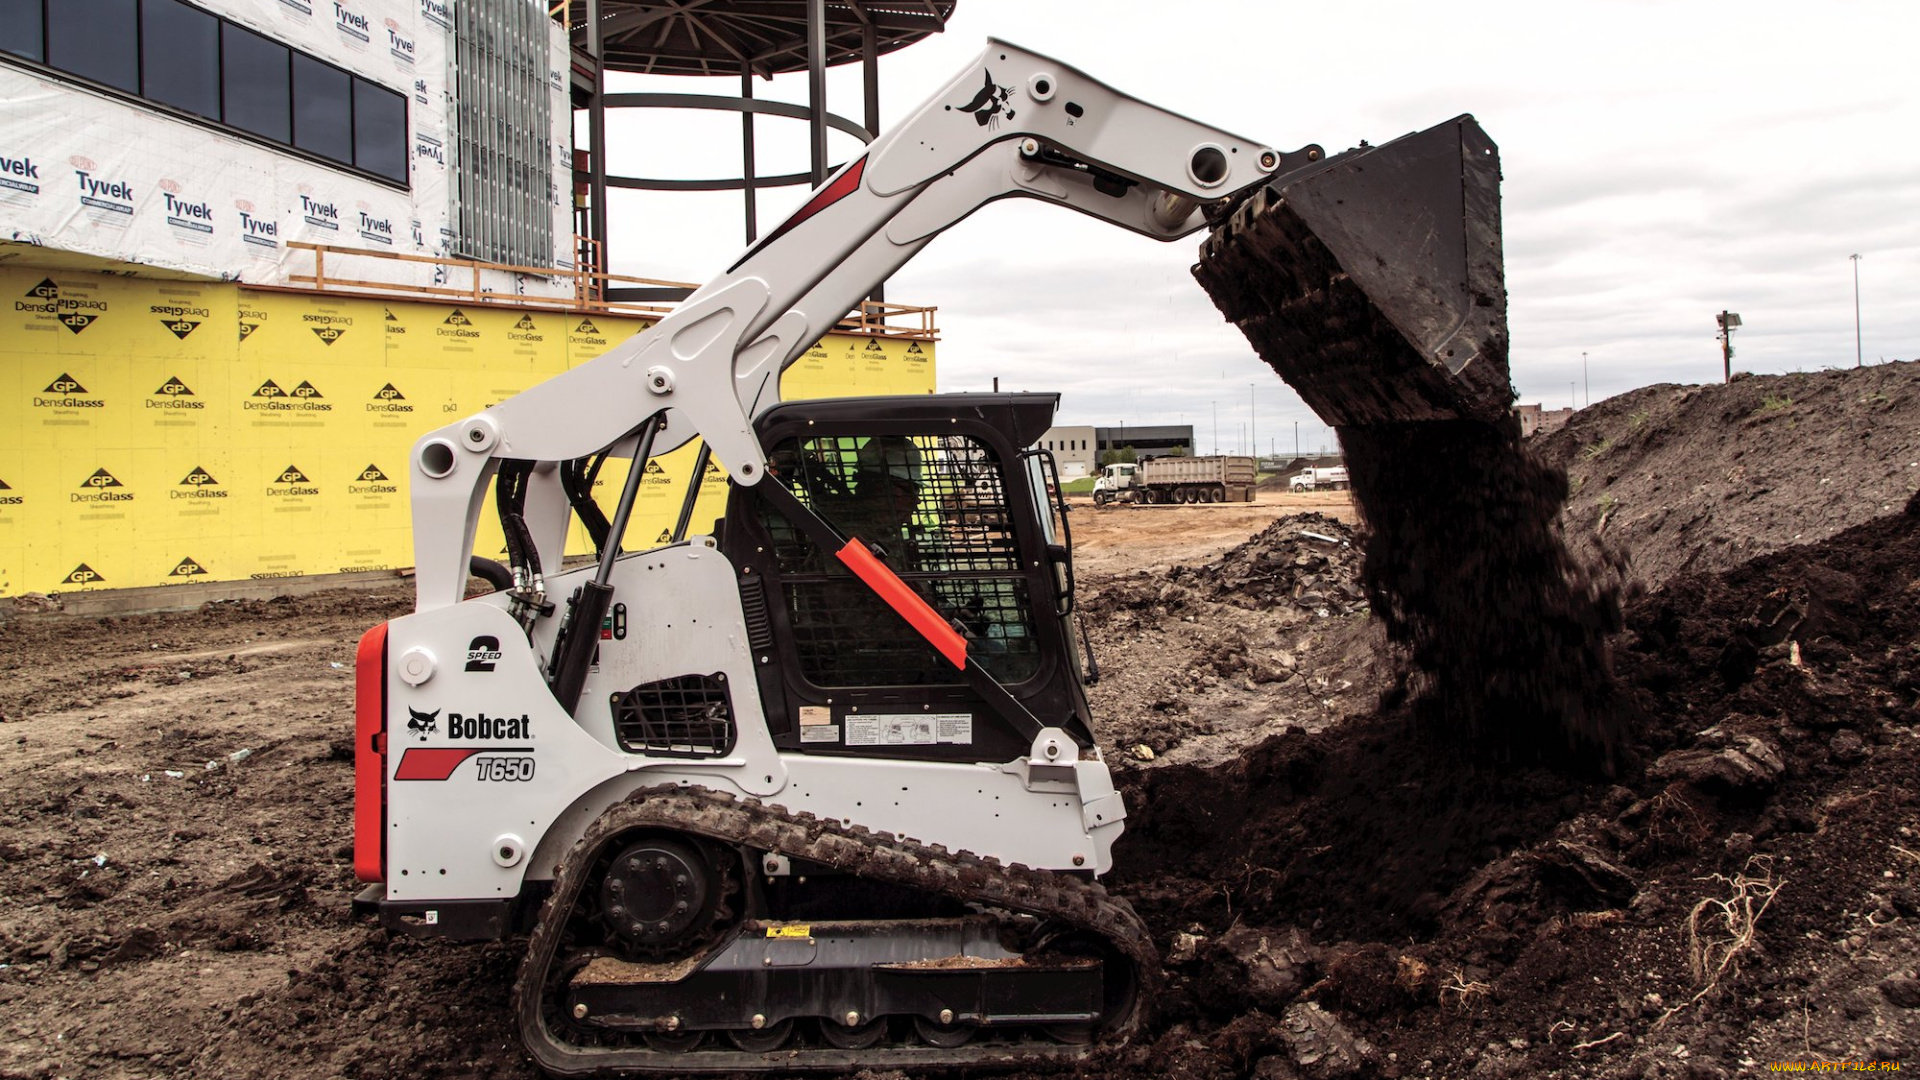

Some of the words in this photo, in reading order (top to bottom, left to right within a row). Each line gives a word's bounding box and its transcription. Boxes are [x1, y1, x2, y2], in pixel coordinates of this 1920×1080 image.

[334, 2, 369, 32] Tyvek
[0, 157, 39, 179] vek
[75, 170, 133, 201] Tyvek
[163, 193, 212, 221] Tyvek
[300, 195, 338, 219] Tyvek
[360, 211, 392, 234] Tyvek
[15, 301, 59, 313] DensGl
[58, 298, 108, 312] DensGla
[150, 305, 210, 318] DensGlass
[302, 314, 353, 326] DensGlass
[449, 315, 465, 325] GP
[436, 328, 480, 338] DensGlass
[579, 324, 593, 333] GP
[569, 336, 606, 346] DensGlass
[52, 381, 77, 392] GP
[163, 384, 185, 394] GP
[260, 386, 280, 396] GP
[296, 387, 315, 397] GP
[380, 389, 398, 399] GP
[145, 399, 205, 409] DensGlass
[243, 401, 291, 411] DensGlas
[290, 402, 332, 411] ensGlass
[366, 403, 414, 413] DensGlass
[647, 465, 660, 473] GP
[89, 475, 113, 486] GP
[188, 474, 209, 484] GP
[282, 472, 302, 482] GP
[363, 471, 381, 480] GP
[641, 476, 671, 485] ensGlass
[170, 489, 228, 499] DensGlass
[266, 487, 319, 497] DensGlass
[348, 485, 397, 494] DensGlass
[70, 492, 134, 503] DensGlass
[176, 564, 199, 575] GP
[70, 571, 95, 582] GP
[467, 652, 502, 660] SPEED
[448, 713, 530, 739] Bobcat
[476, 757, 535, 782] T650
